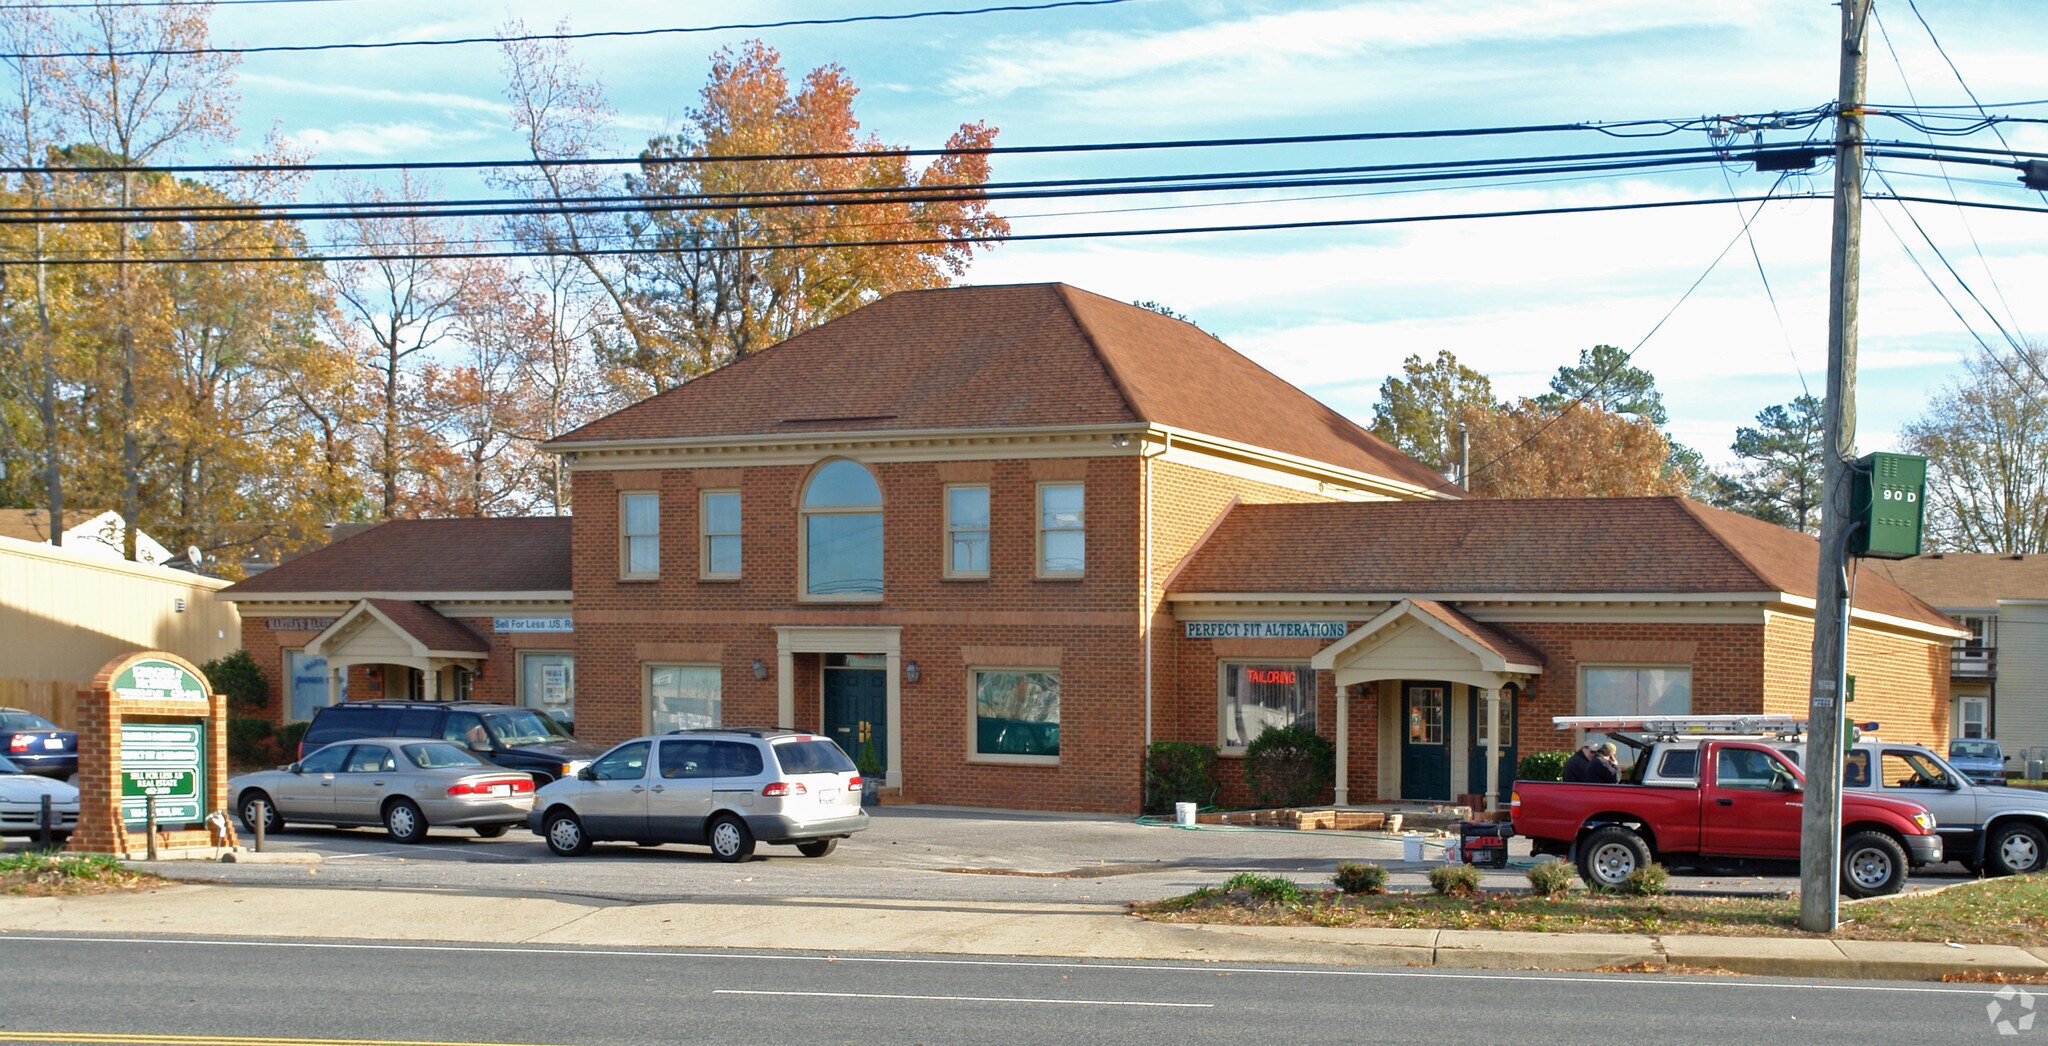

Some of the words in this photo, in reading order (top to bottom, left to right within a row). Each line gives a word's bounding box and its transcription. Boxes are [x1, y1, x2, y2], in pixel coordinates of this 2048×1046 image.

[1883, 489, 1903, 501] 90
[1907, 491, 1917, 503] D
[268, 618, 305, 630] MARTHA'S
[495, 619, 509, 628] Sell
[511, 619, 524, 628] For
[526, 619, 546, 628] Less
[1188, 622, 1240, 637] PERFECT
[1243, 622, 1262, 637] FIT
[1264, 622, 1345, 637] ALTERATIONS
[1247, 669, 1297, 685] TAILORING
